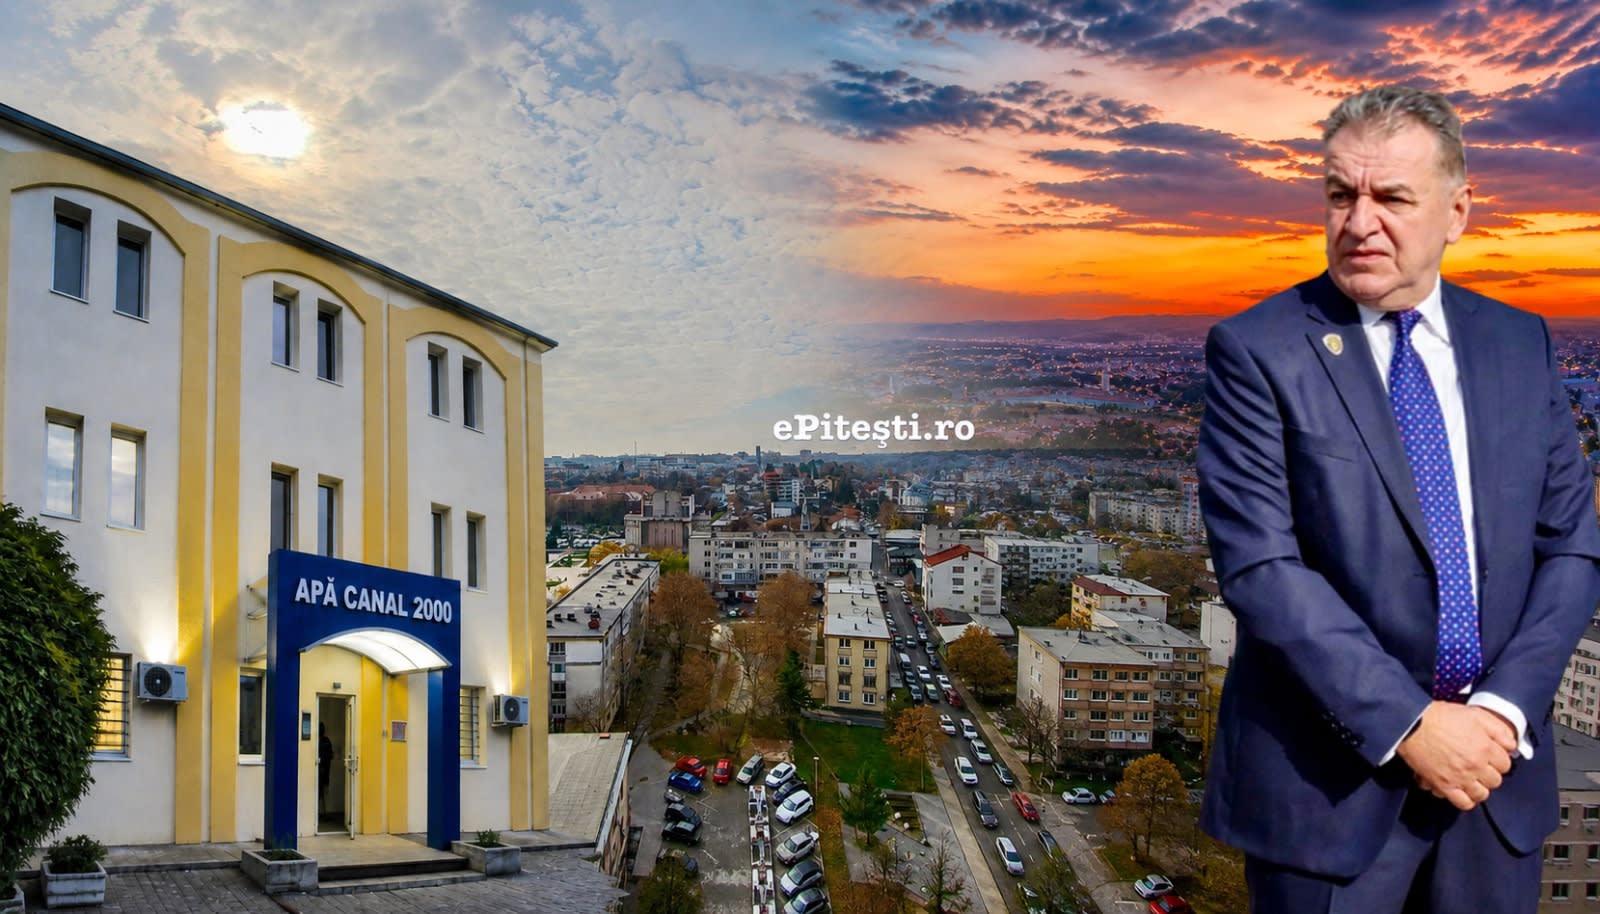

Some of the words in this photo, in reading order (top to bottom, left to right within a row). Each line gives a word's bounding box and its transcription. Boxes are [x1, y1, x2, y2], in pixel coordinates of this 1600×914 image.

[294, 576, 338, 608] APĂ
[343, 585, 408, 617] CANAL
[412, 597, 452, 623] 2000
